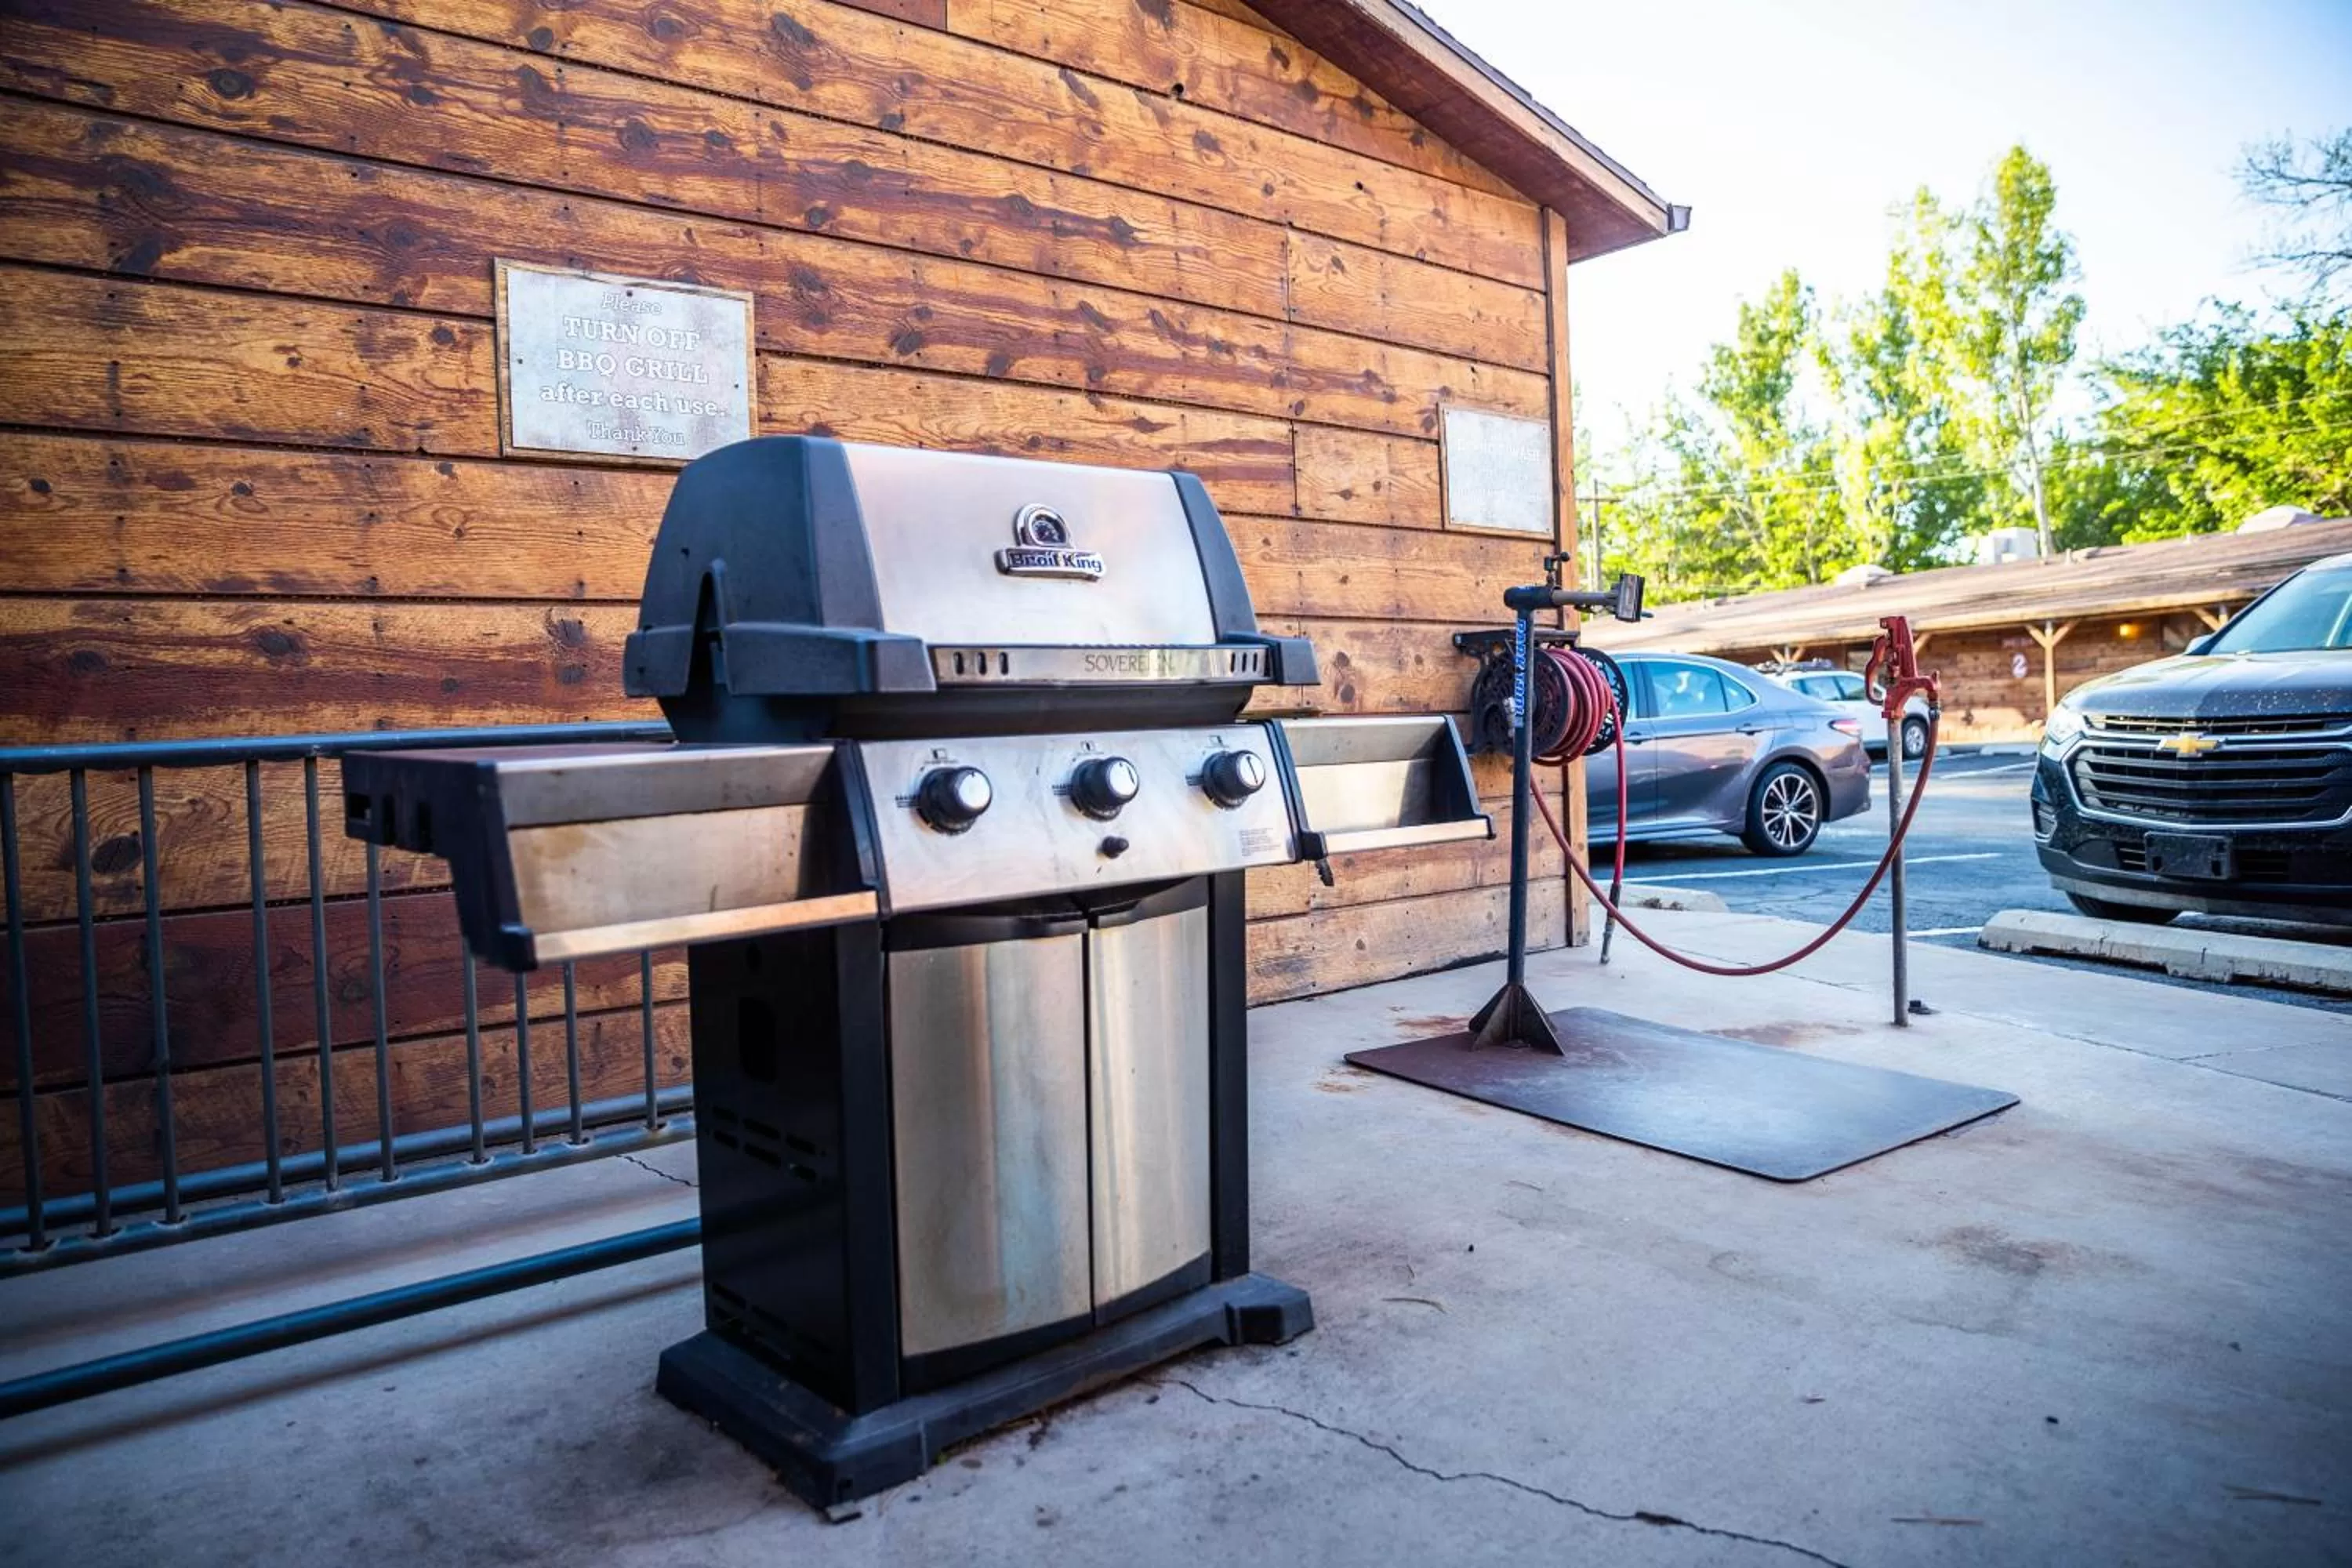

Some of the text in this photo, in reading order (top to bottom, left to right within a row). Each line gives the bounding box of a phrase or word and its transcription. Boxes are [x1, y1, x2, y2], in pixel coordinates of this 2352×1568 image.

[601, 292, 662, 314] Please
[563, 317, 700, 351] TURN OFF
[557, 349, 708, 384] BBQ GRILL
[539, 382, 727, 417] after each use.
[587, 420, 685, 445] Thank You
[1010, 550, 1102, 572] Broil King
[1084, 654, 1174, 673] SOVEREIN
